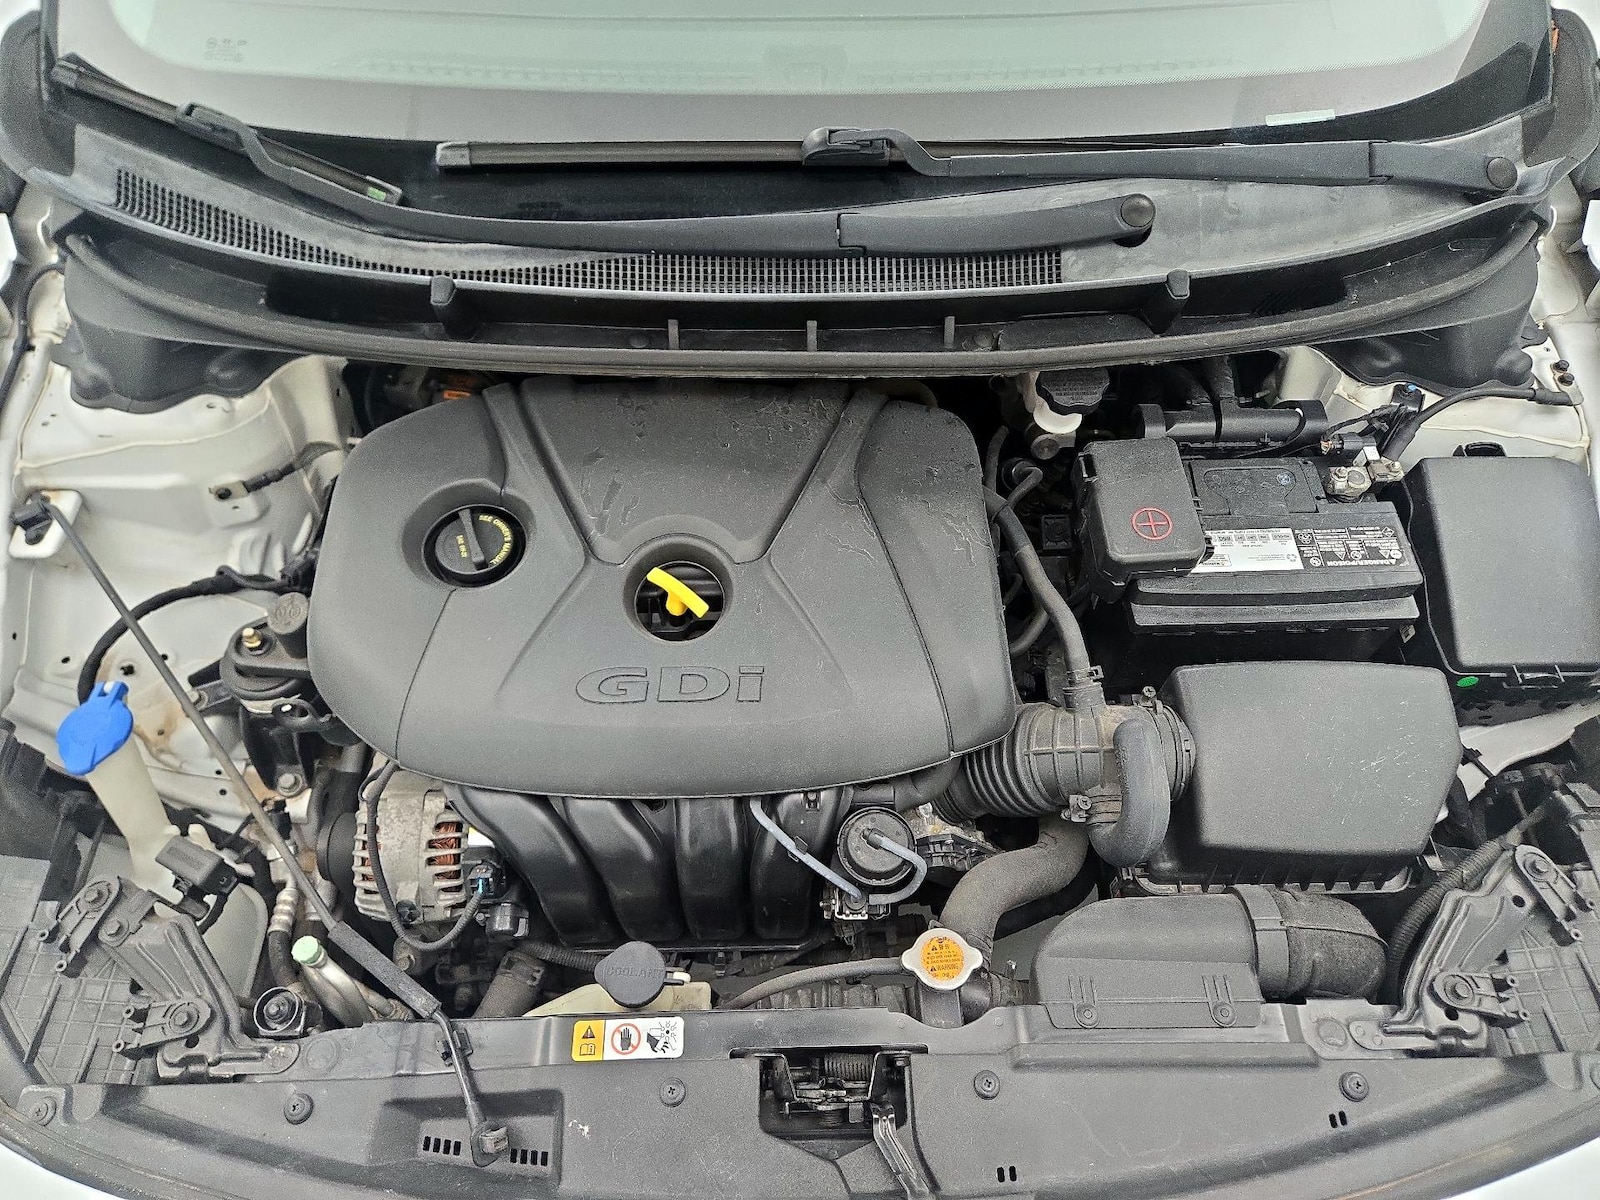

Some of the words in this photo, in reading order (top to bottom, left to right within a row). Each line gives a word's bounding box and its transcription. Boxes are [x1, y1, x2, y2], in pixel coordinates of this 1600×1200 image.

[489, 542, 511, 564] MANUAL
[575, 665, 765, 704] GDi
[937, 963, 959, 971] WARNING
